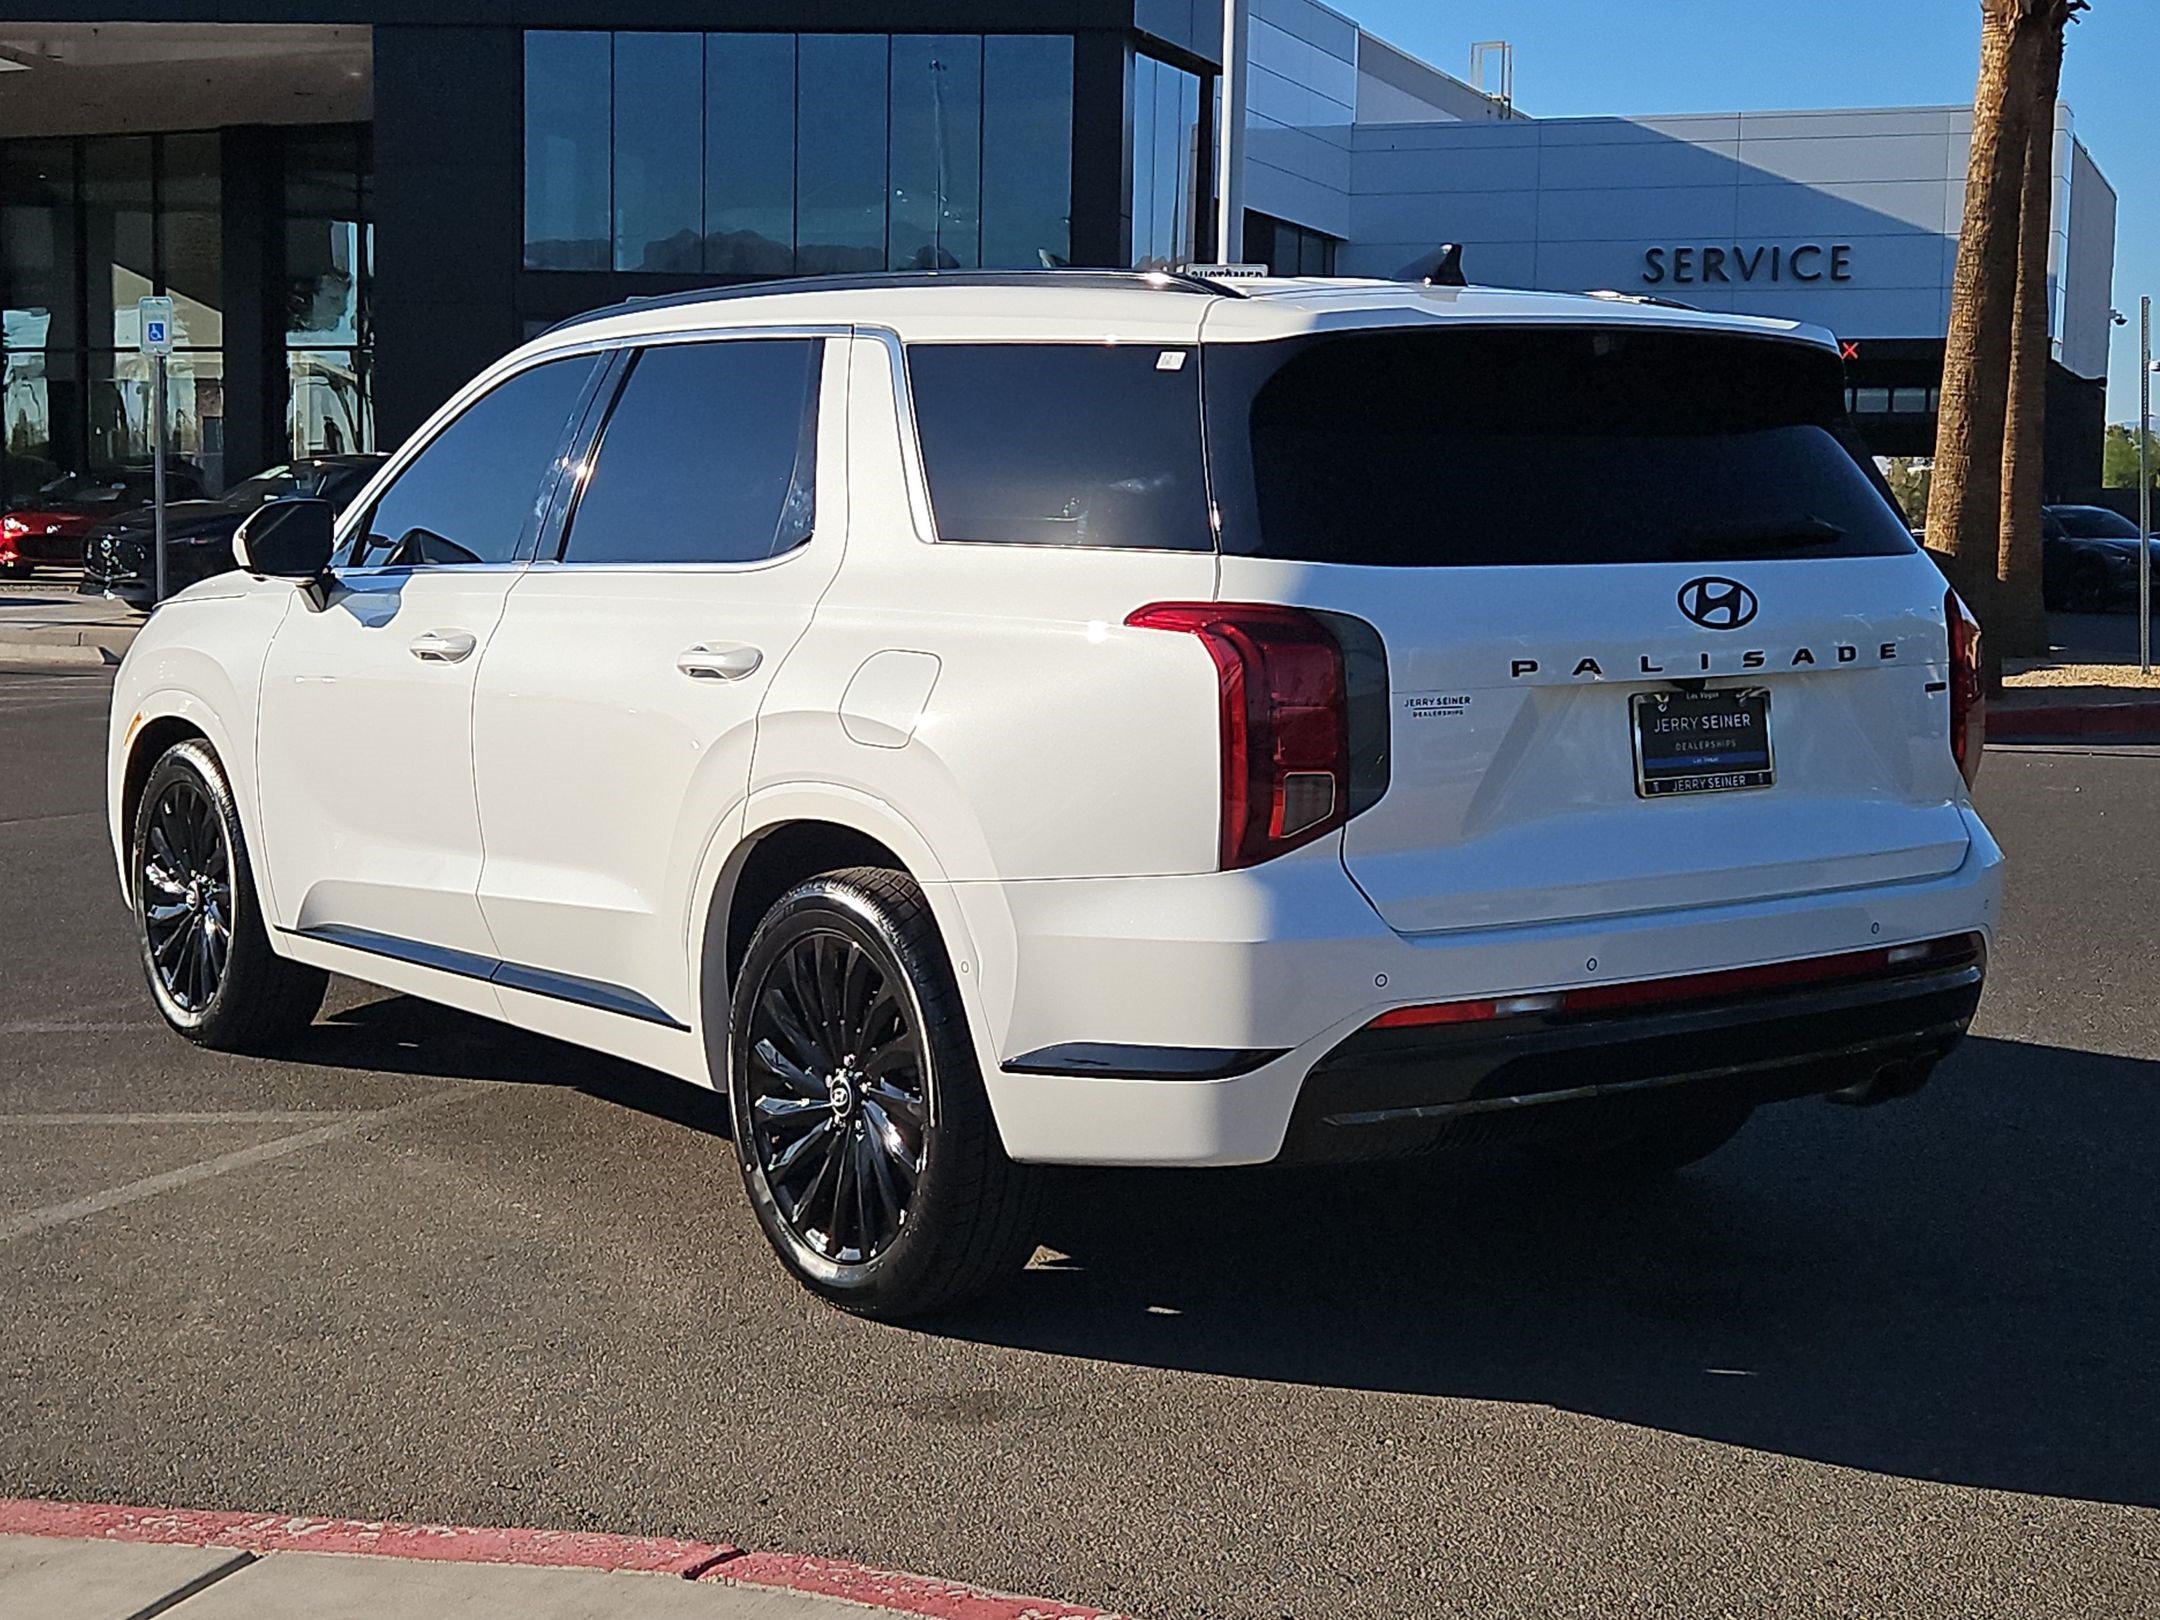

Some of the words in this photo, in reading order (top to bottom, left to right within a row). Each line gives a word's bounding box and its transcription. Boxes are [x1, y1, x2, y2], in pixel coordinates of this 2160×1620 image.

[1642, 244, 1852, 283] SERVICE
[1511, 642, 1897, 678] PALISADE
[1404, 697, 1435, 708] JERRY
[1437, 696, 1471, 706] SEINER
[1654, 716, 1699, 733] JERRY
[1701, 713, 1751, 729] SEINER
[1675, 738, 1737, 751] DEALERSHIPS
[1673, 778, 1706, 792] JERRY
[1708, 775, 1746, 789] SEINER
